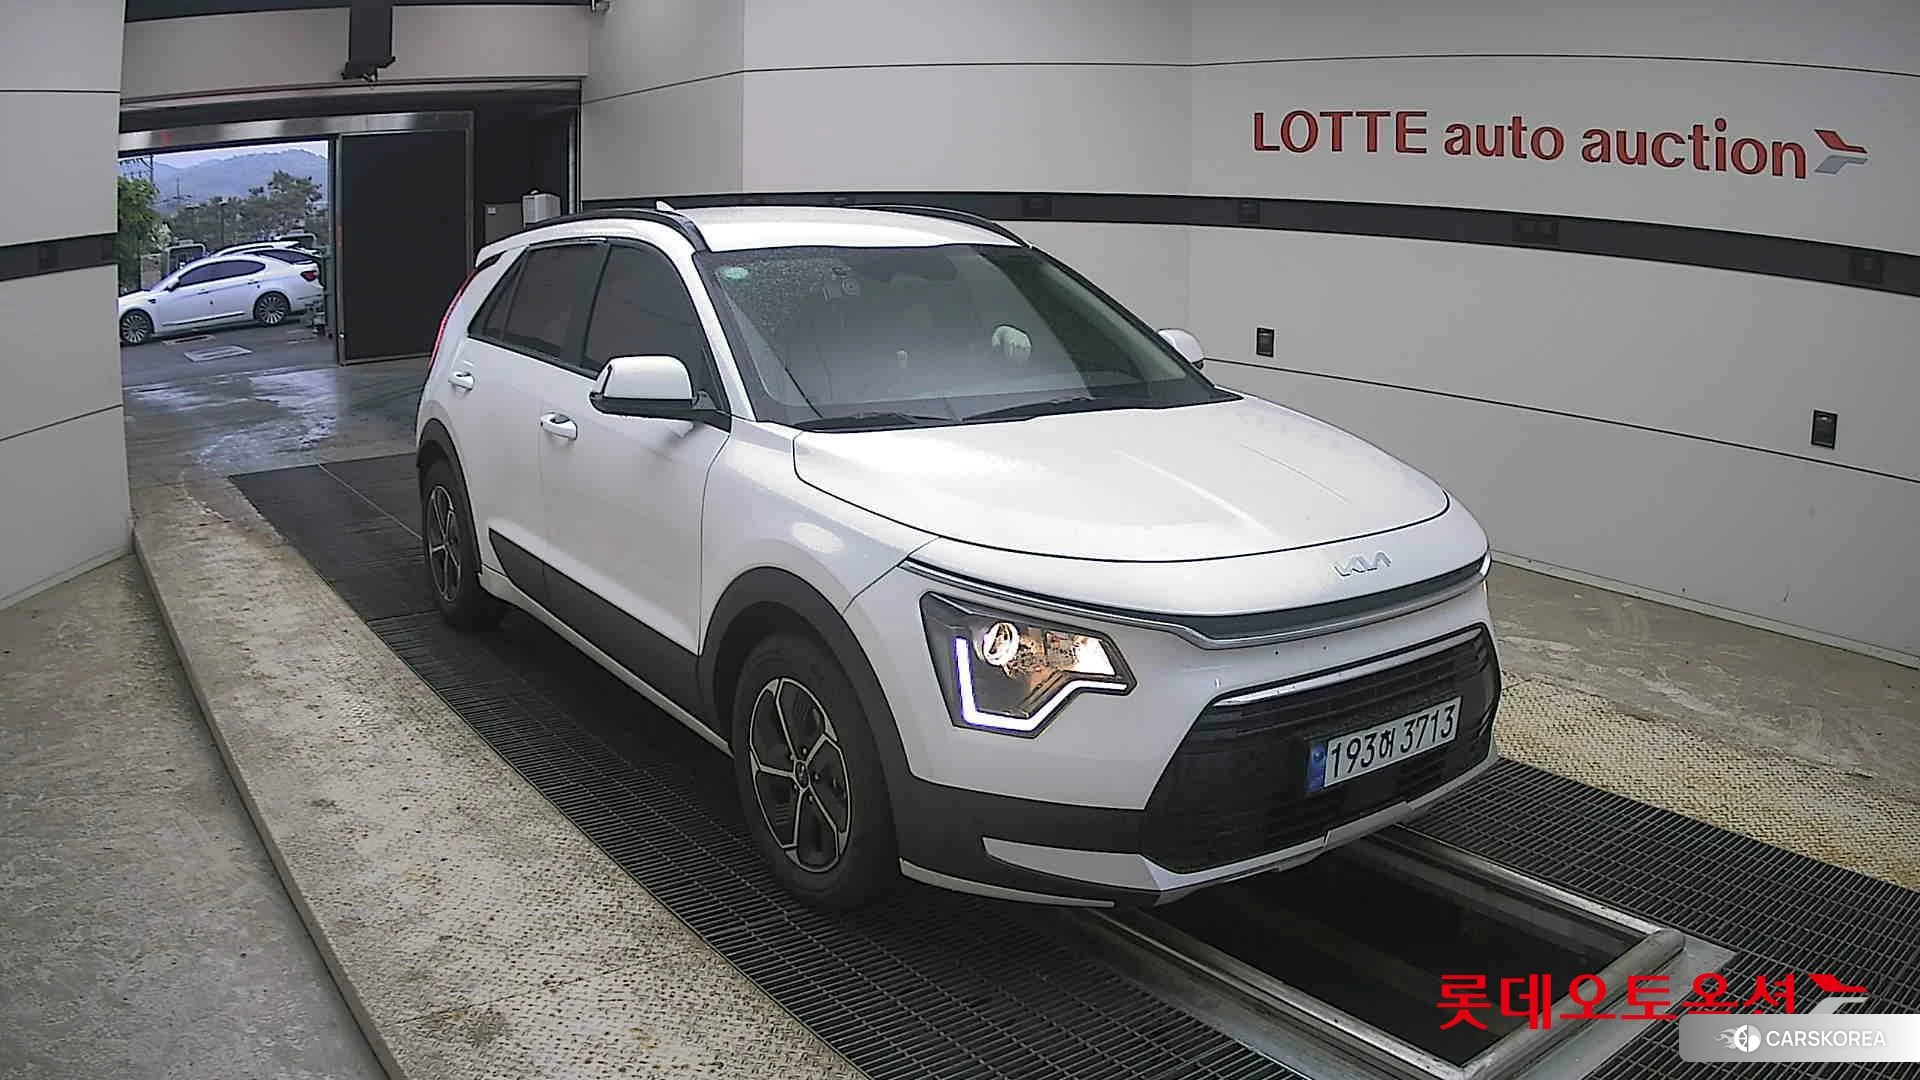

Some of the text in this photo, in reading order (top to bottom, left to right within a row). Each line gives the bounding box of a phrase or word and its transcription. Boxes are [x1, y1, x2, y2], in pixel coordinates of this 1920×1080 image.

[1253, 111, 1807, 179] LOTTE auto auction
[1331, 704, 1456, 778] 193허 3713
